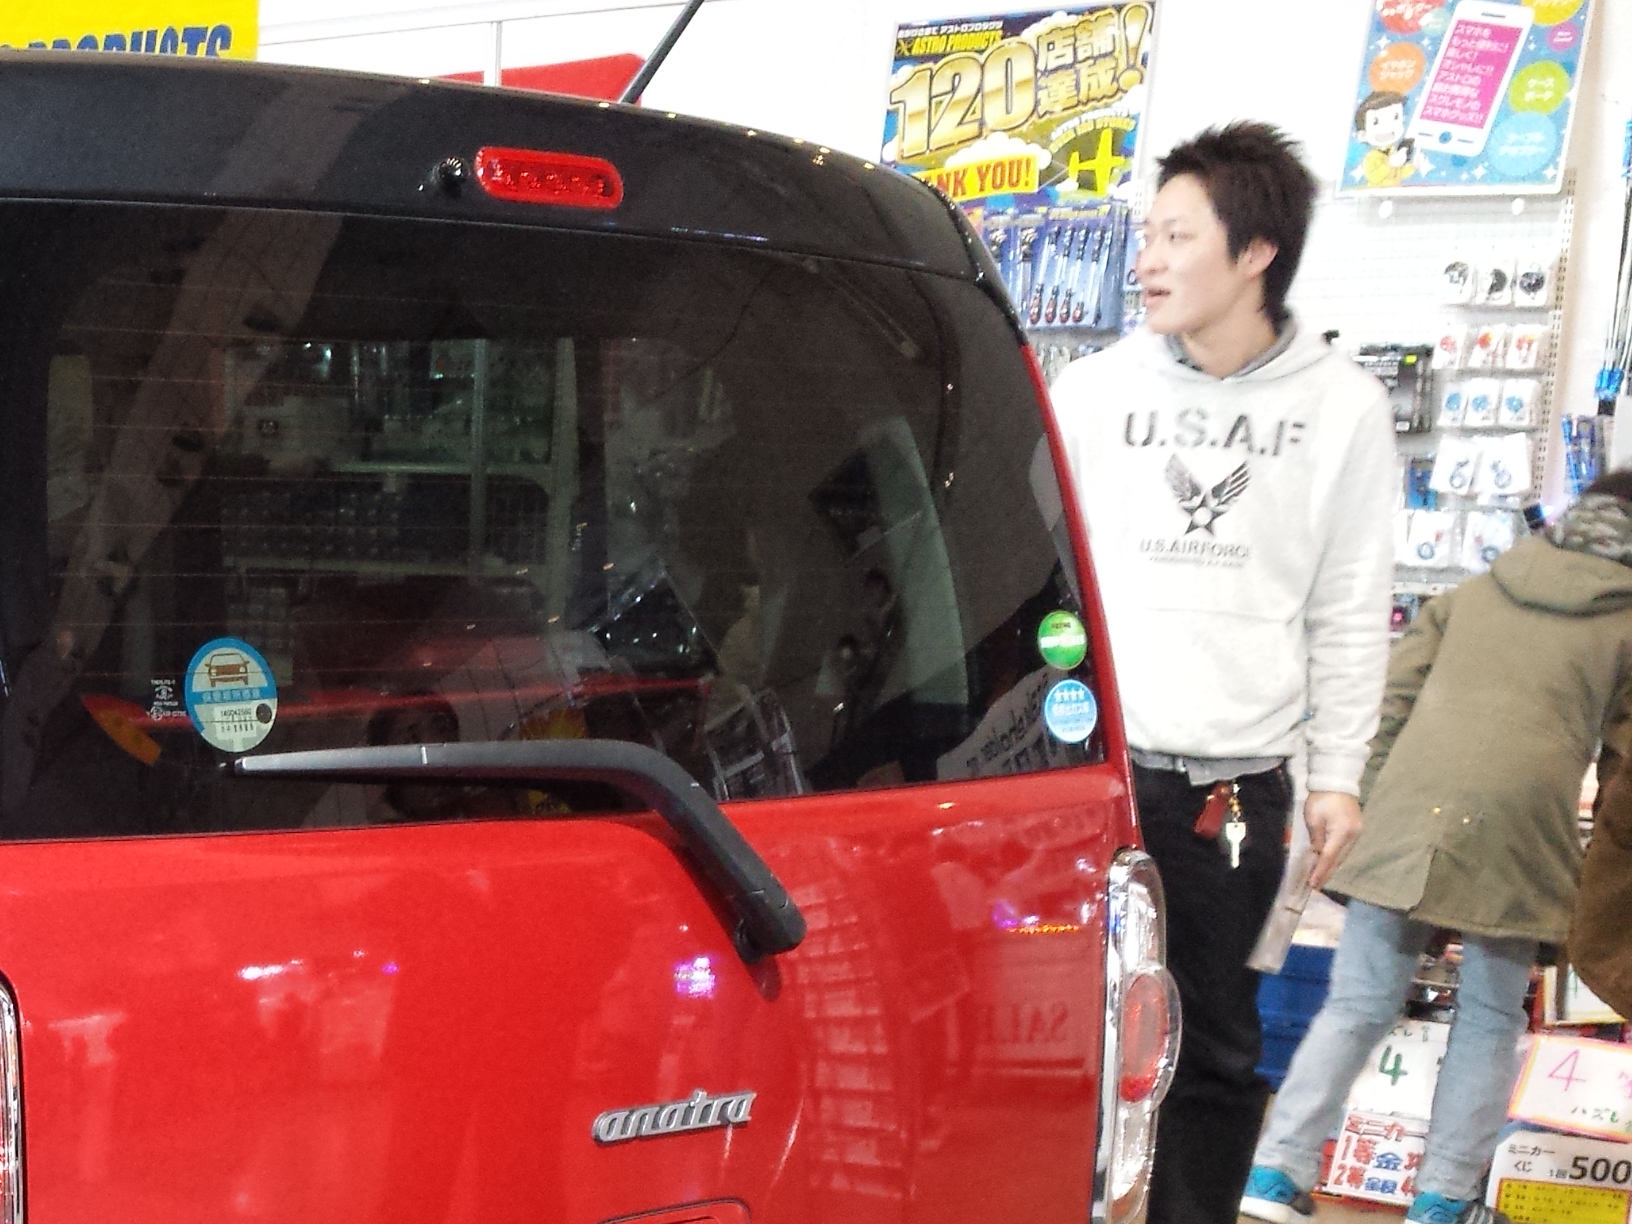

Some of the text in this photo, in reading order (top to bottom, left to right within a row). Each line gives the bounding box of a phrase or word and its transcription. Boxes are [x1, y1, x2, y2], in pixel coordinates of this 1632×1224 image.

[911, 29, 1003, 55] ASTRO PRODUCTS
[890, 41, 1036, 158] 120
[976, 158, 1031, 192] YOU!
[1379, 1045, 1408, 1086] 4
[1547, 1048, 1587, 1092] 4
[592, 1088, 756, 1146] anatra
[1508, 1144, 1555, 1156] ミニカー
[1514, 1160, 1532, 1172] くじ
[1569, 1156, 1631, 1184] 500
